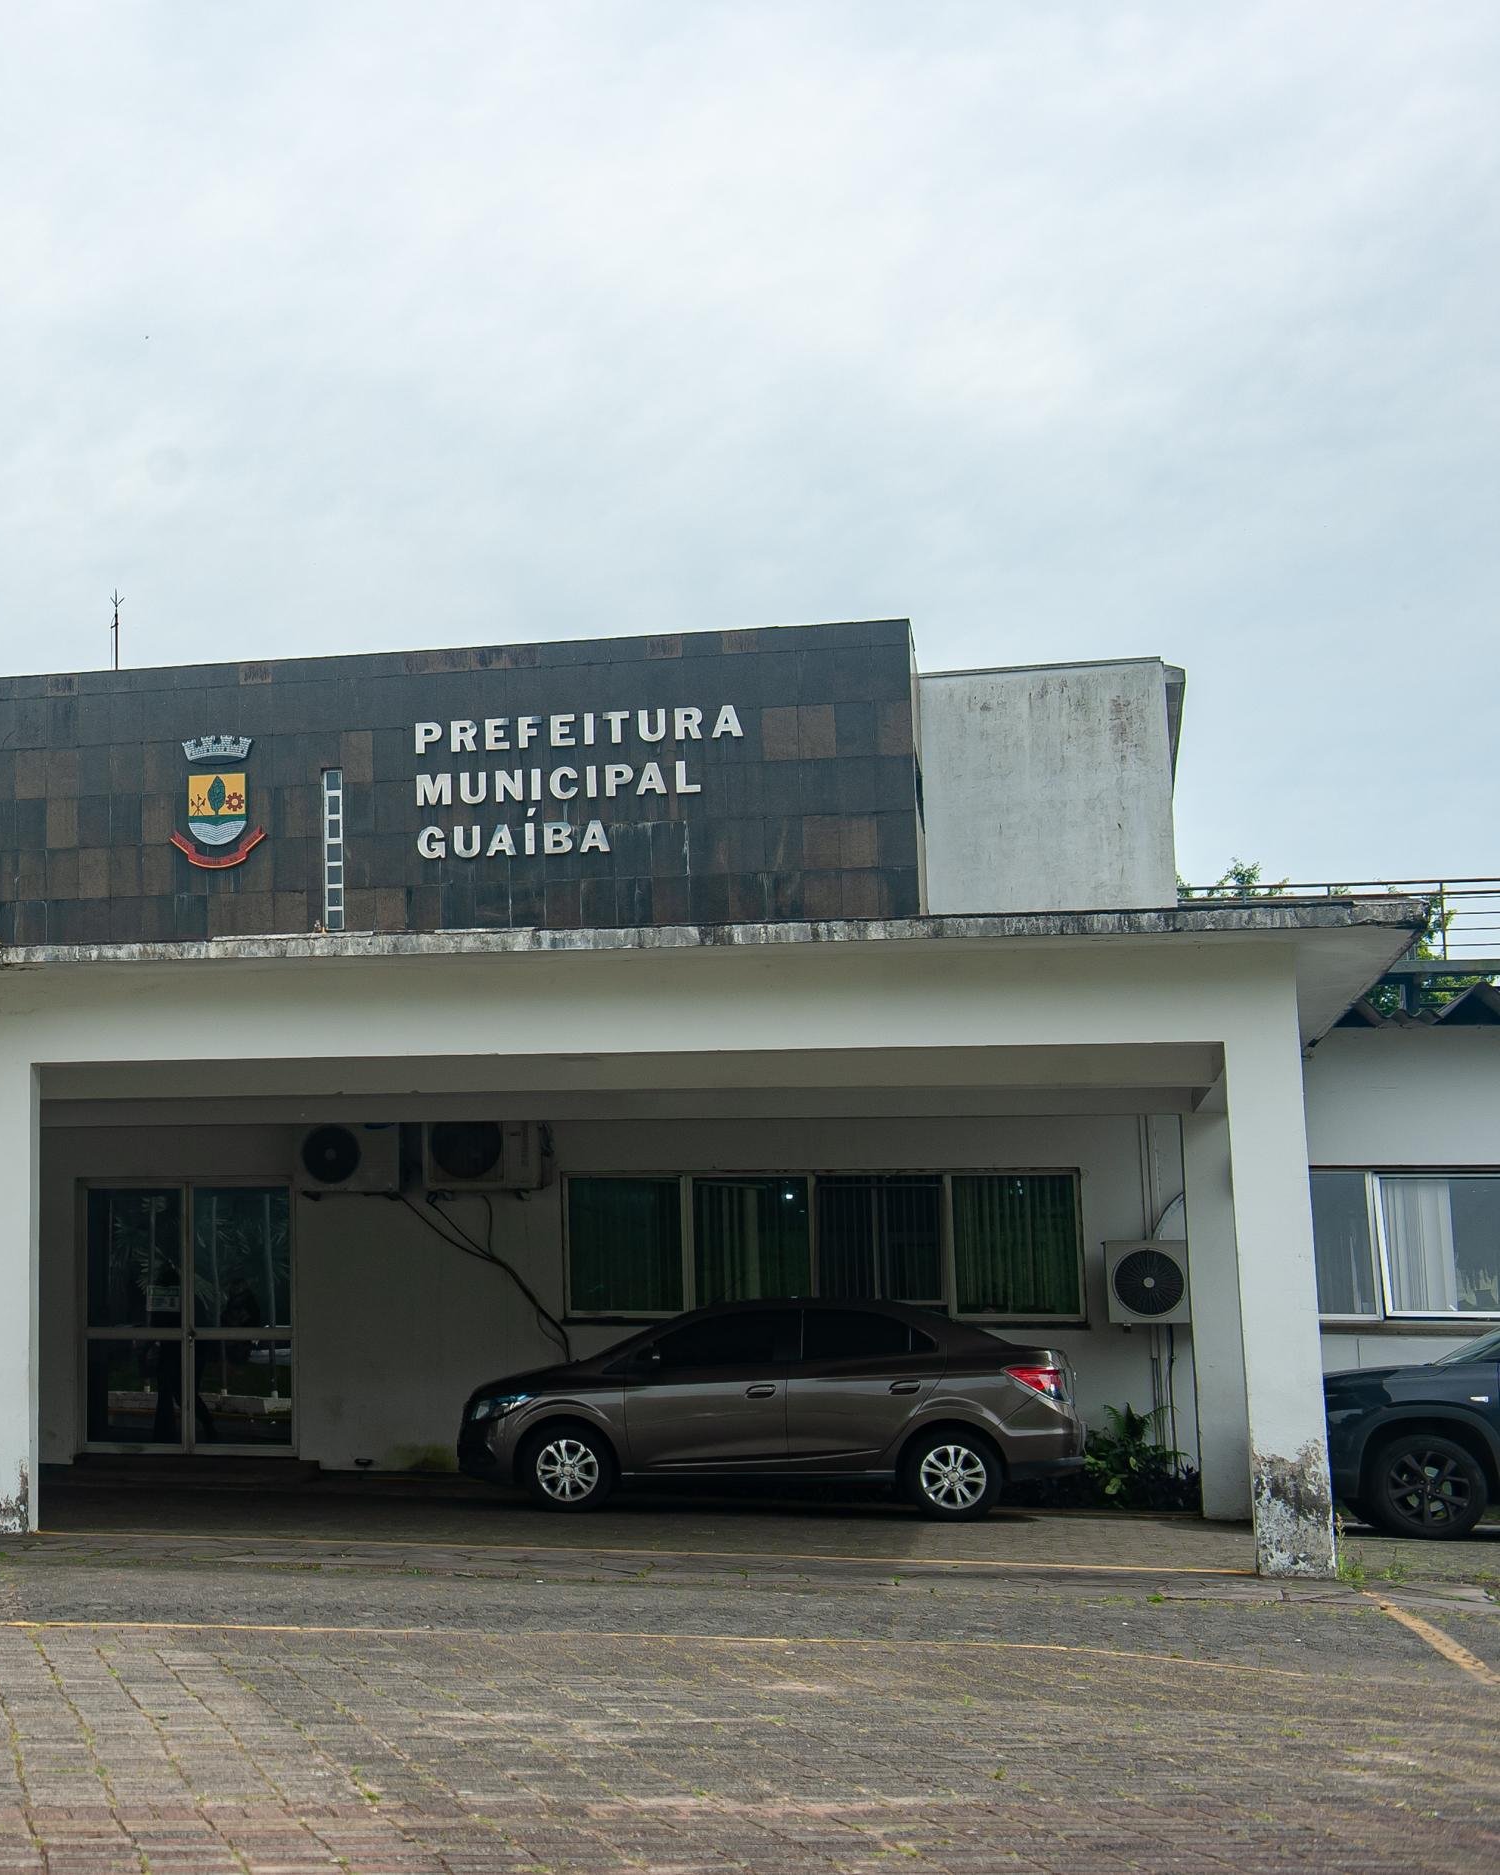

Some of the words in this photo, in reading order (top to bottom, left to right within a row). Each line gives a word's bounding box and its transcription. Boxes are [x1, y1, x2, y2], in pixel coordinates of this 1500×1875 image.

[414, 704, 744, 754] PREFEITURA
[416, 760, 701, 806] MUNICIPAL
[416, 807, 611, 859] GUAÍBA
